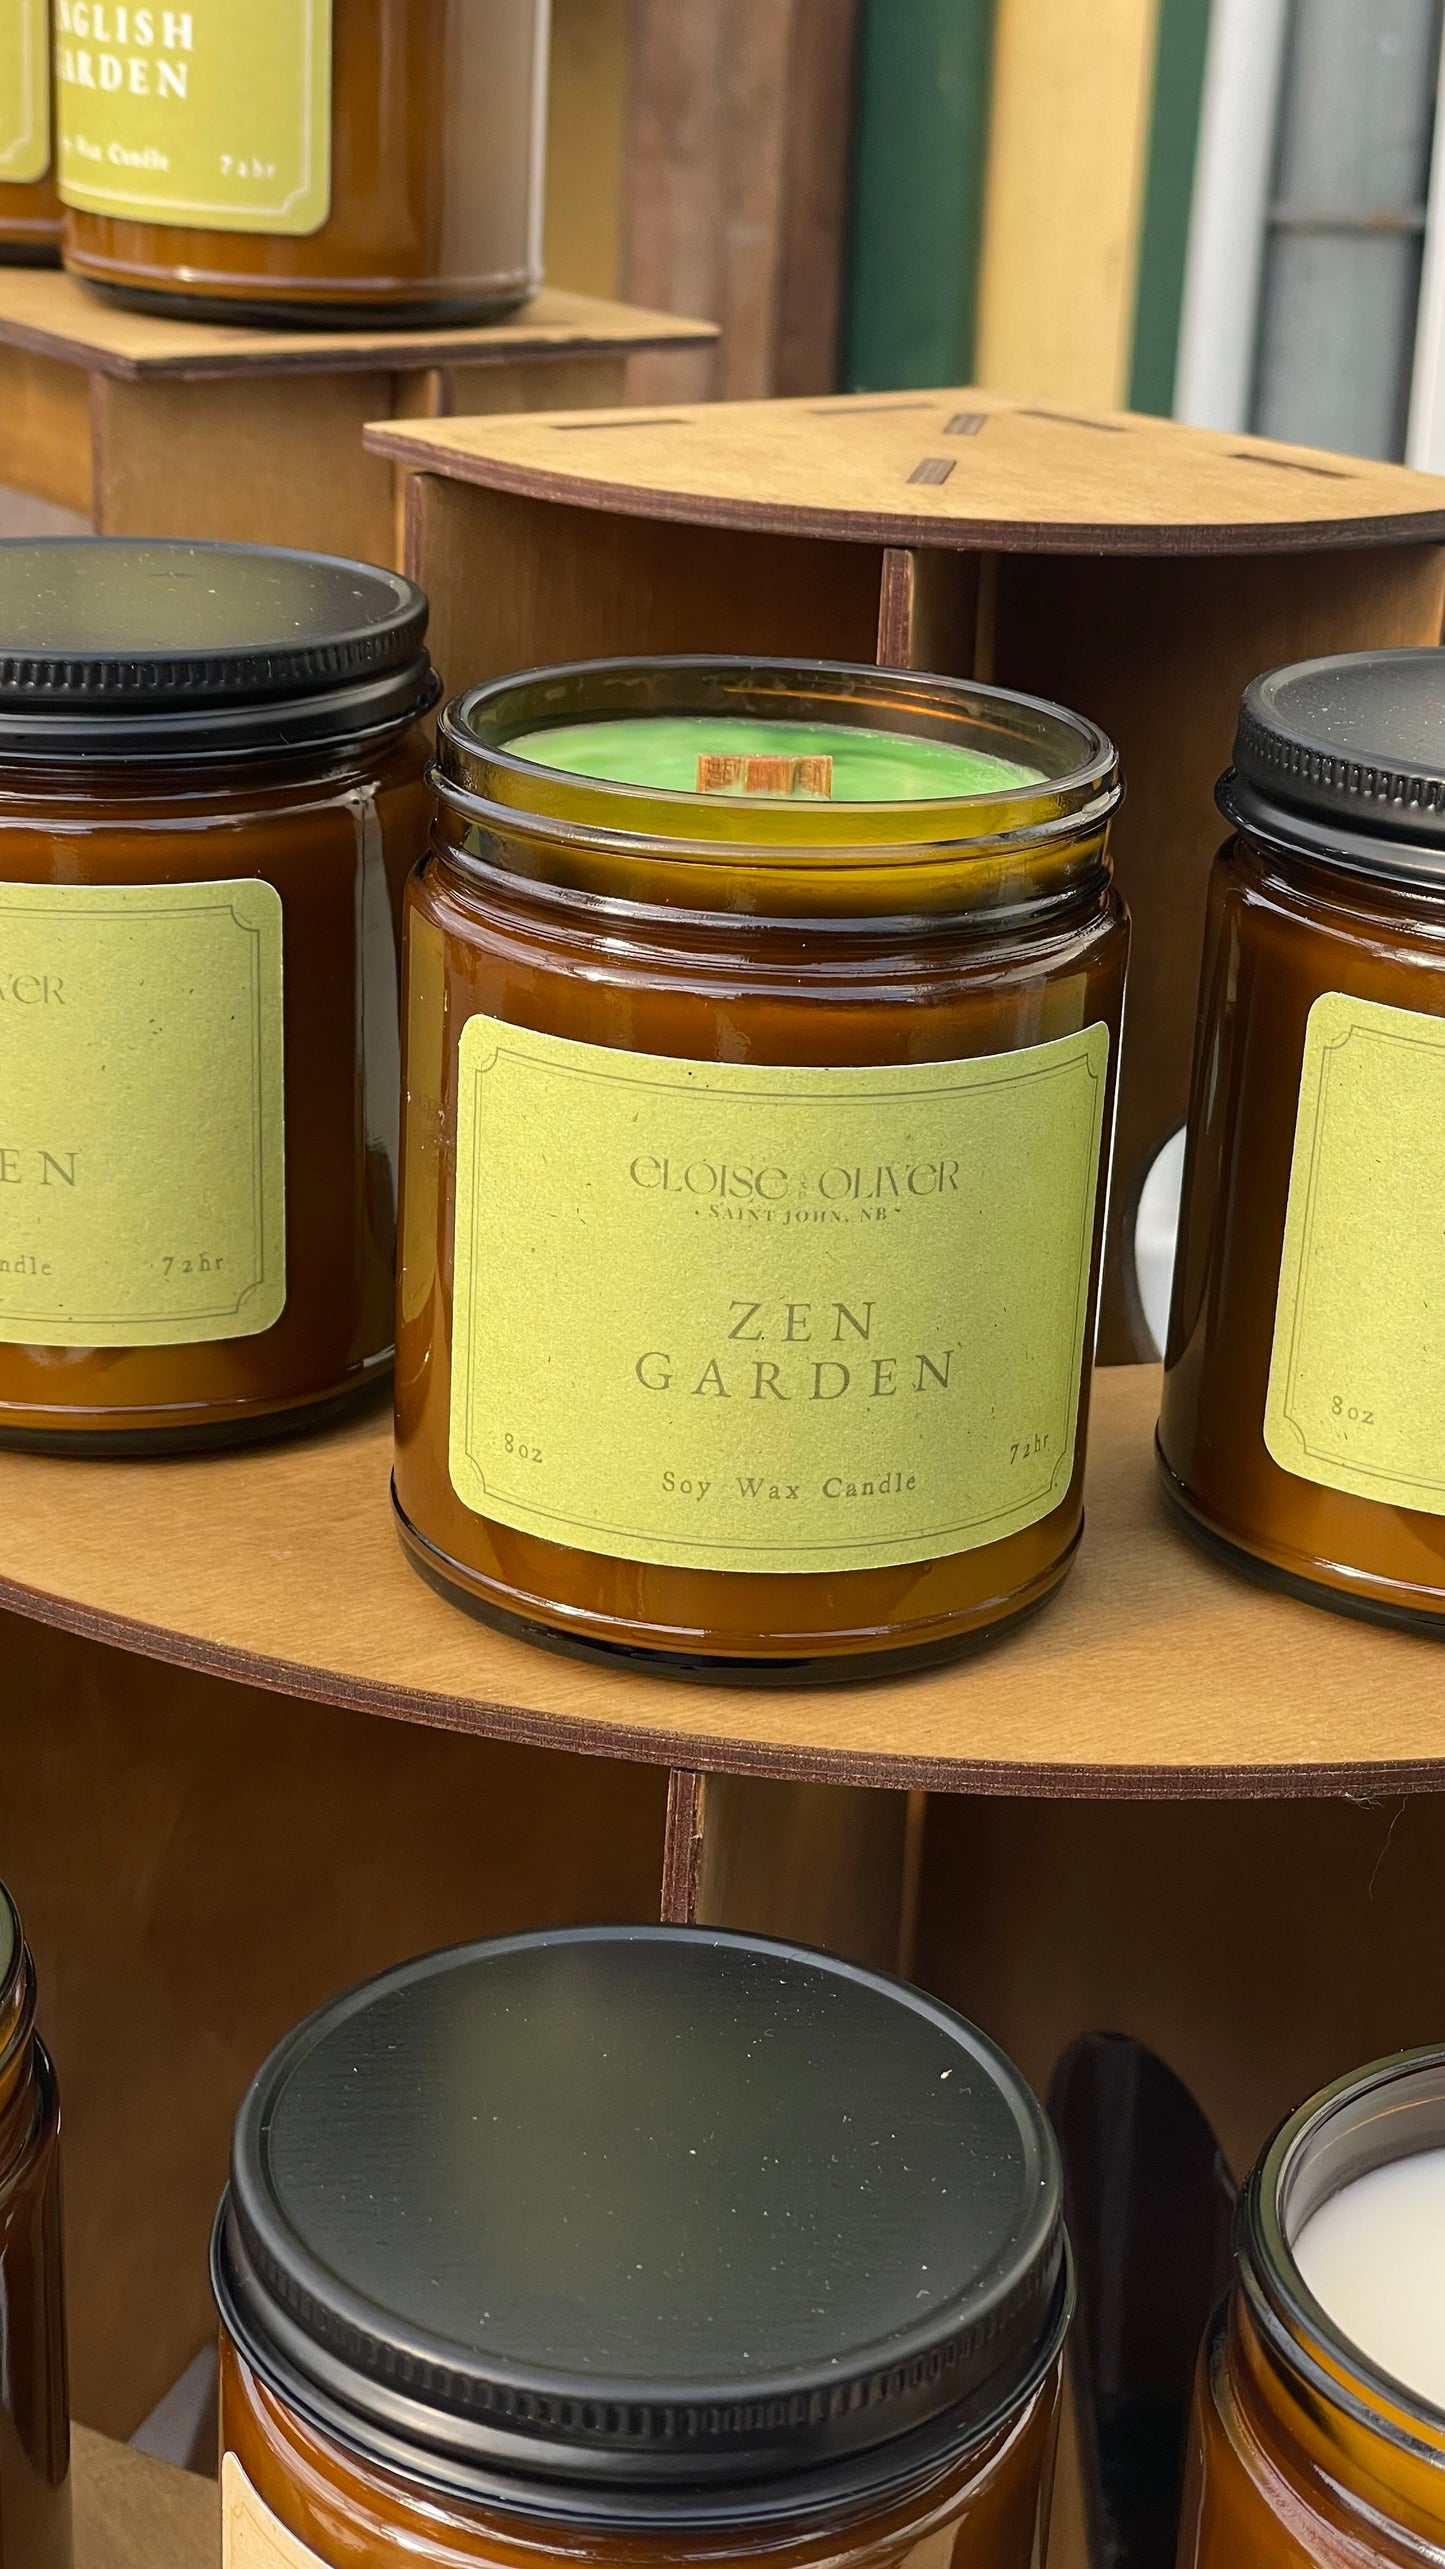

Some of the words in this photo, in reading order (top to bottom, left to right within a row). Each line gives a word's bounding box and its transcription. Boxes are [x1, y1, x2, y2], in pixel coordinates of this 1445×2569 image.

[709, 1203, 777, 1223] SAINT
[162, 1250, 224, 1276] 72hr
[727, 1300, 876, 1342] ZEN
[635, 1350, 955, 1401] GARDEN
[1331, 1395, 1375, 1426] 8oz
[504, 1432, 543, 1464] 8oz
[1010, 1433, 1049, 1465] 72hr
[661, 1470, 711, 1501] Soy
[736, 1477, 800, 1500] Wax
[822, 1472, 916, 1499] Candle
